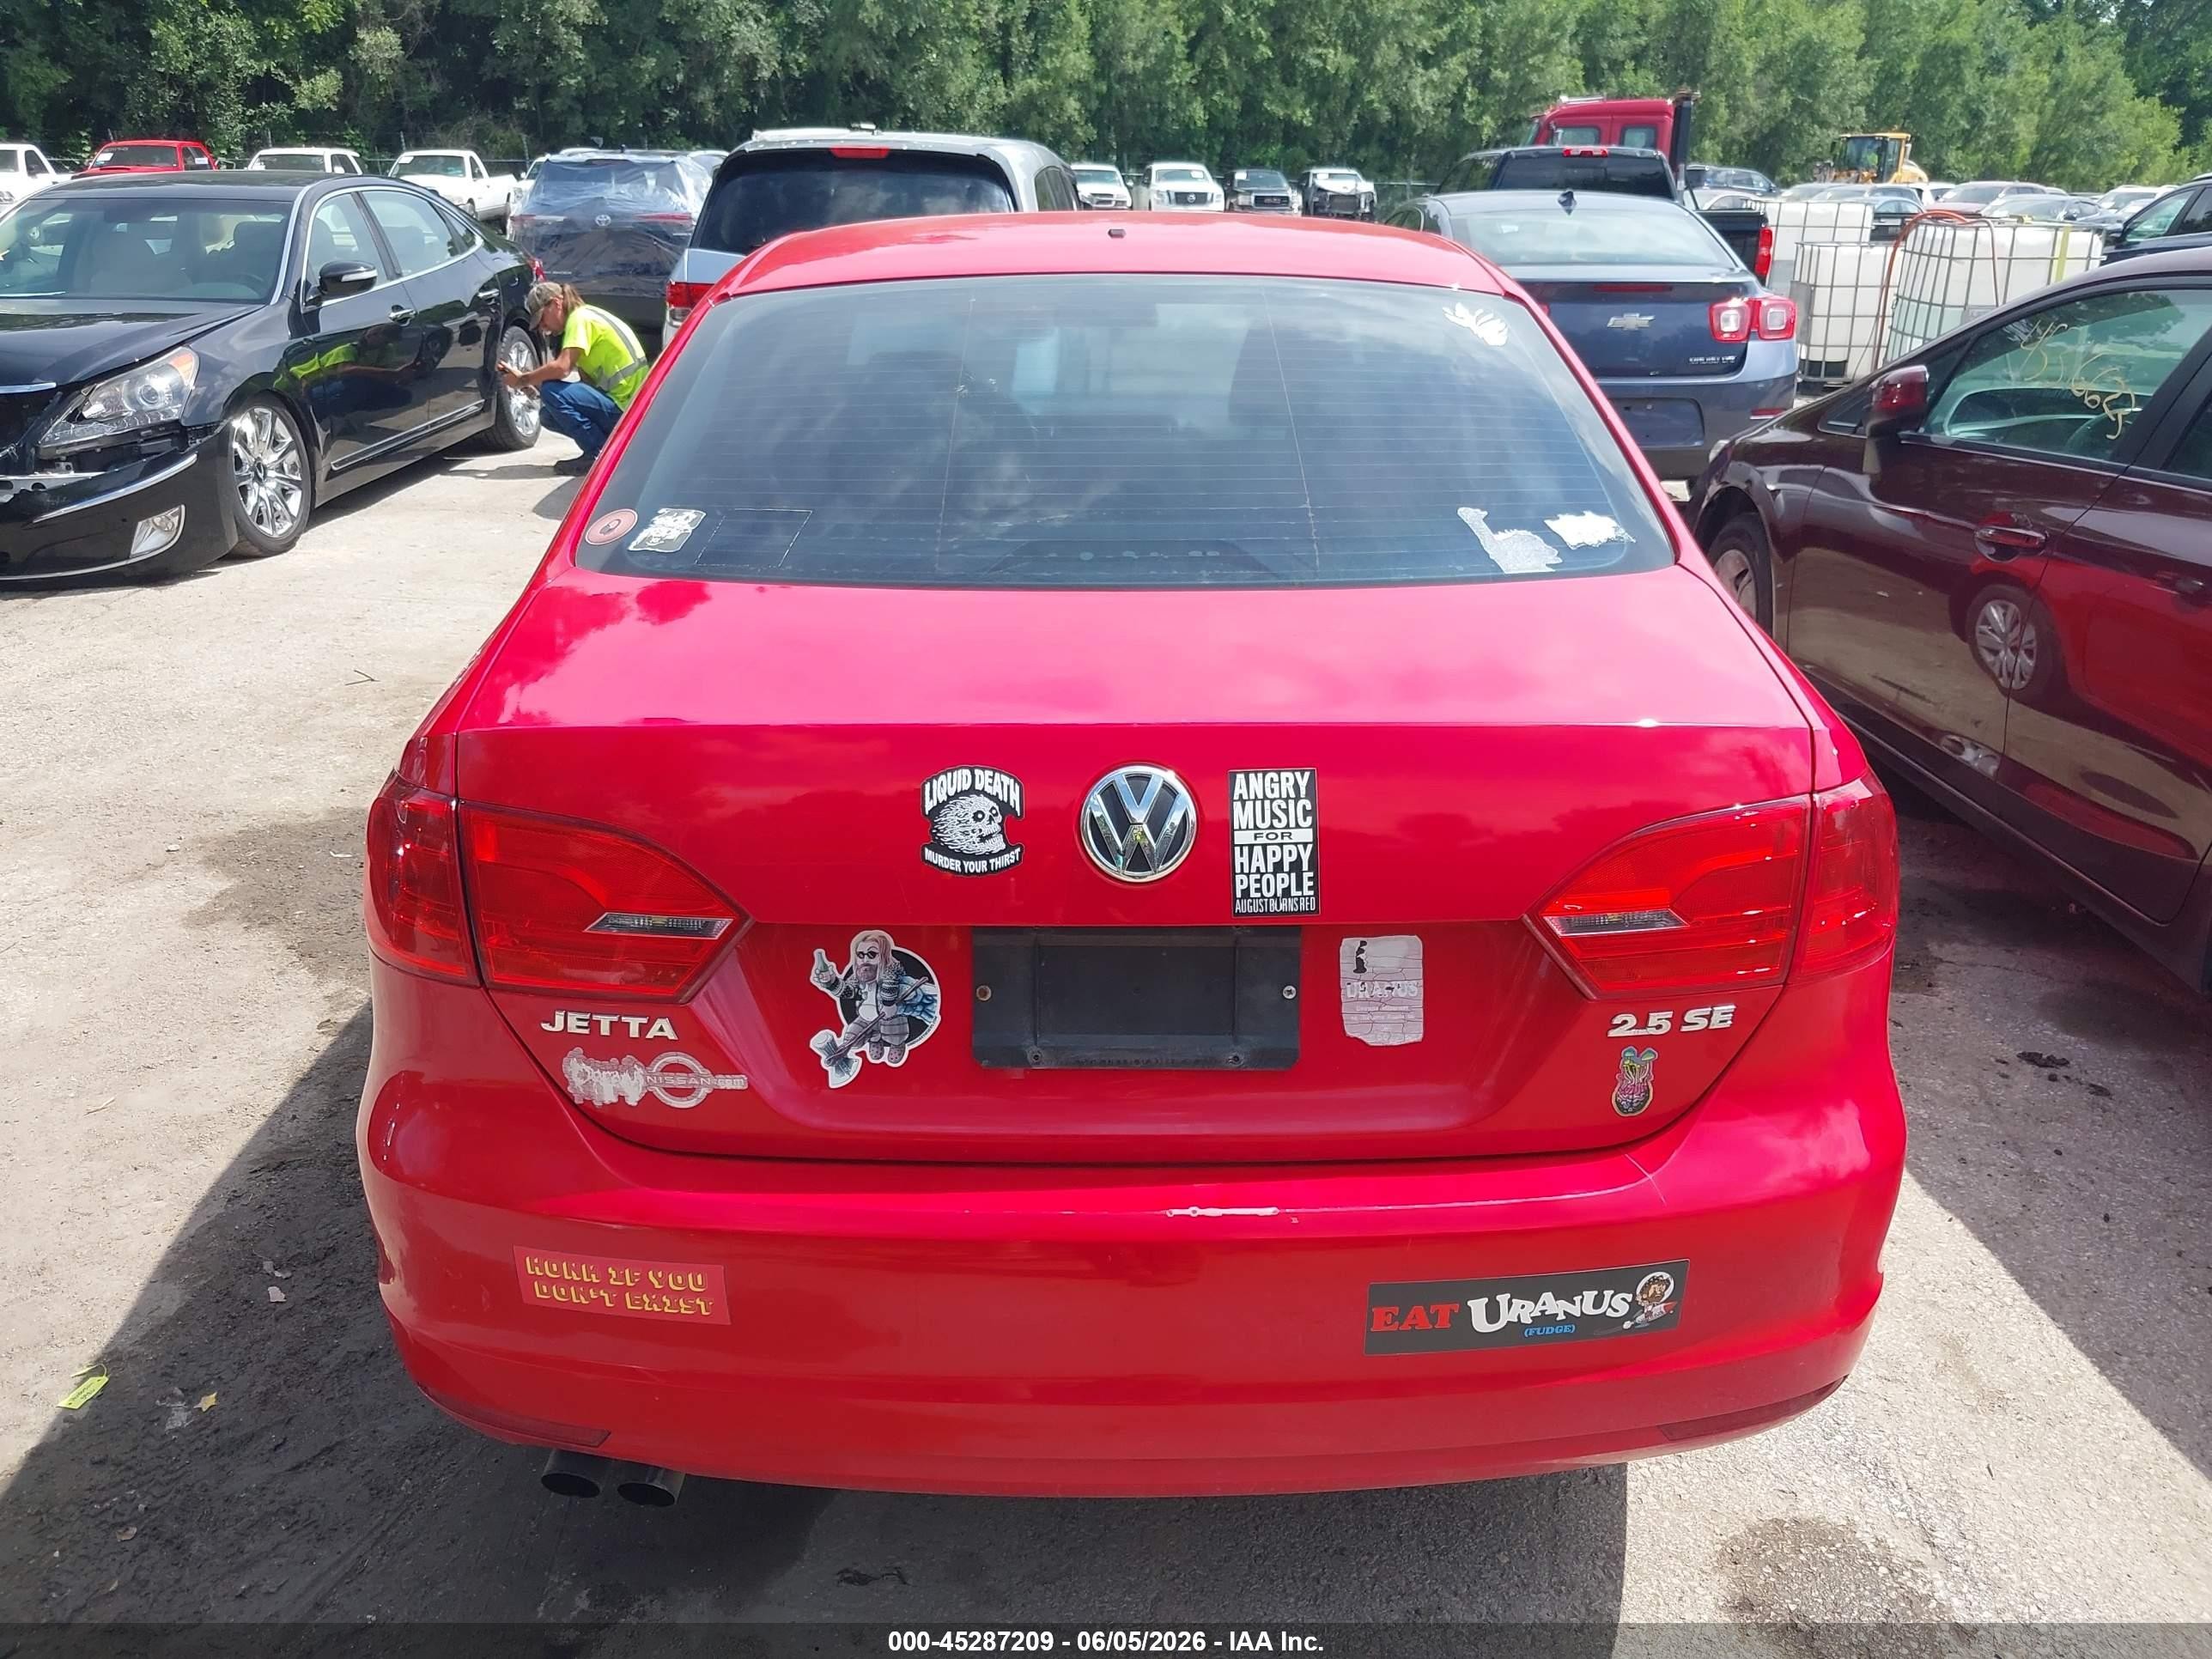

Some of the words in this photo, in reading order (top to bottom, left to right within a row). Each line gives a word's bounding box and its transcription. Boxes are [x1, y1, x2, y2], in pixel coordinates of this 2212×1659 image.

[924, 769, 972, 816] LIQUID
[975, 769, 1020, 817] DEATH
[1233, 771, 1310, 800] ANGRY
[1233, 799, 1313, 830] MUSIC
[1254, 831, 1293, 841] FOR
[924, 847, 962, 873] MURDER
[963, 860, 988, 873] YOUR
[989, 847, 1021, 871] THIRST
[1234, 844, 1314, 873] HAPPY
[1235, 872, 1315, 898] PEOPLE
[540, 1010, 679, 1040] JETTA
[1680, 1004, 1736, 1032] SE
[526, 1255, 600, 1284] HONK
[608, 1266, 641, 1286] IF
[648, 1269, 708, 1292] YOU
[533, 1280, 618, 1307] DON'T
[624, 1291, 714, 1316] EXIST
[1370, 1302, 1460, 1332] EAT
[1467, 1290, 1633, 1334] URANUS
[1523, 1323, 1577, 1338] (FUDGE)
